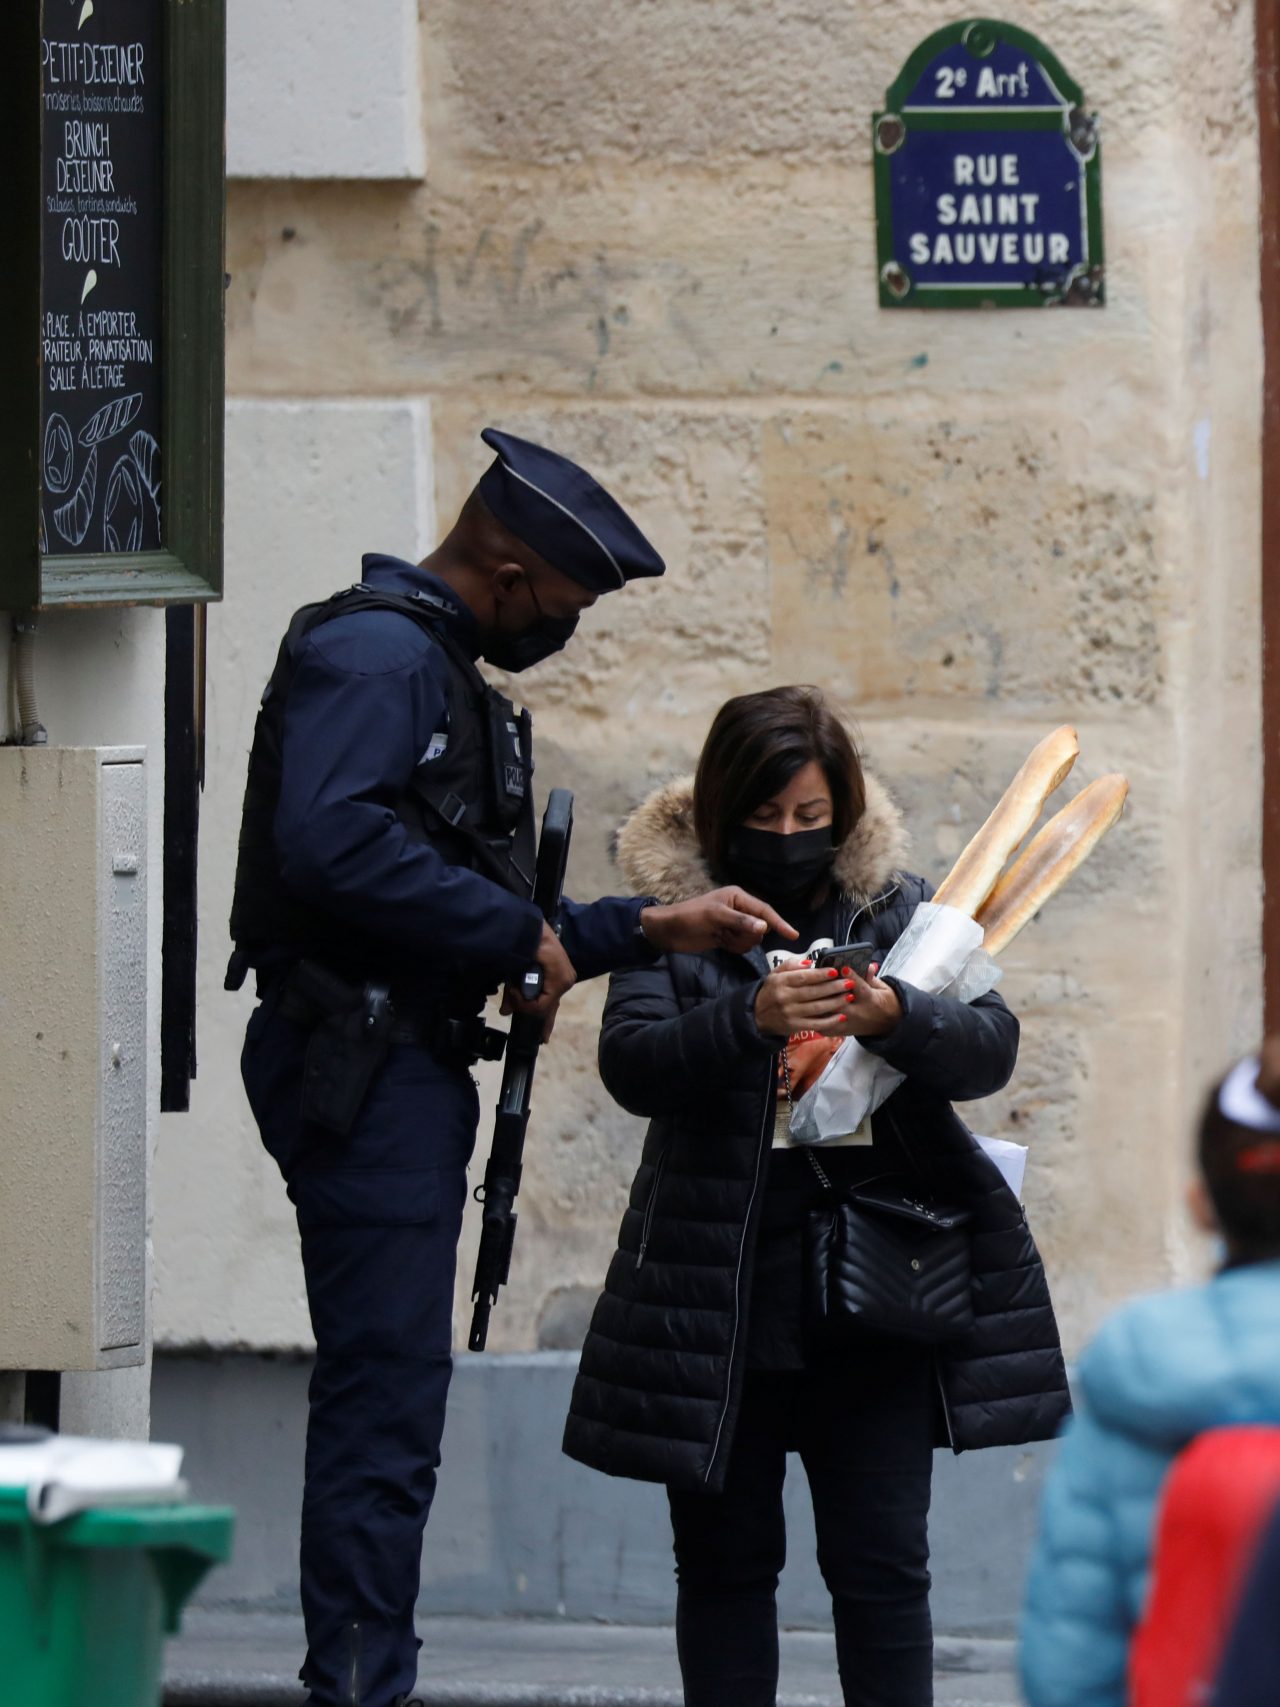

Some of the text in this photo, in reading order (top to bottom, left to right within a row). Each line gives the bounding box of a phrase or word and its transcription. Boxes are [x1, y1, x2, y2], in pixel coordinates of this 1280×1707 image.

[65, 120, 110, 158] BRUNCH
[57, 158, 115, 192] DEJEUNER
[953, 154, 1020, 186] RUE
[936, 193, 1039, 225] SAINT
[62, 214, 121, 268] GOÛTER
[909, 232, 1070, 265] SAUVEUR
[89, 339, 153, 364] PRIVATISATION
[49, 366, 76, 391] SALLE
